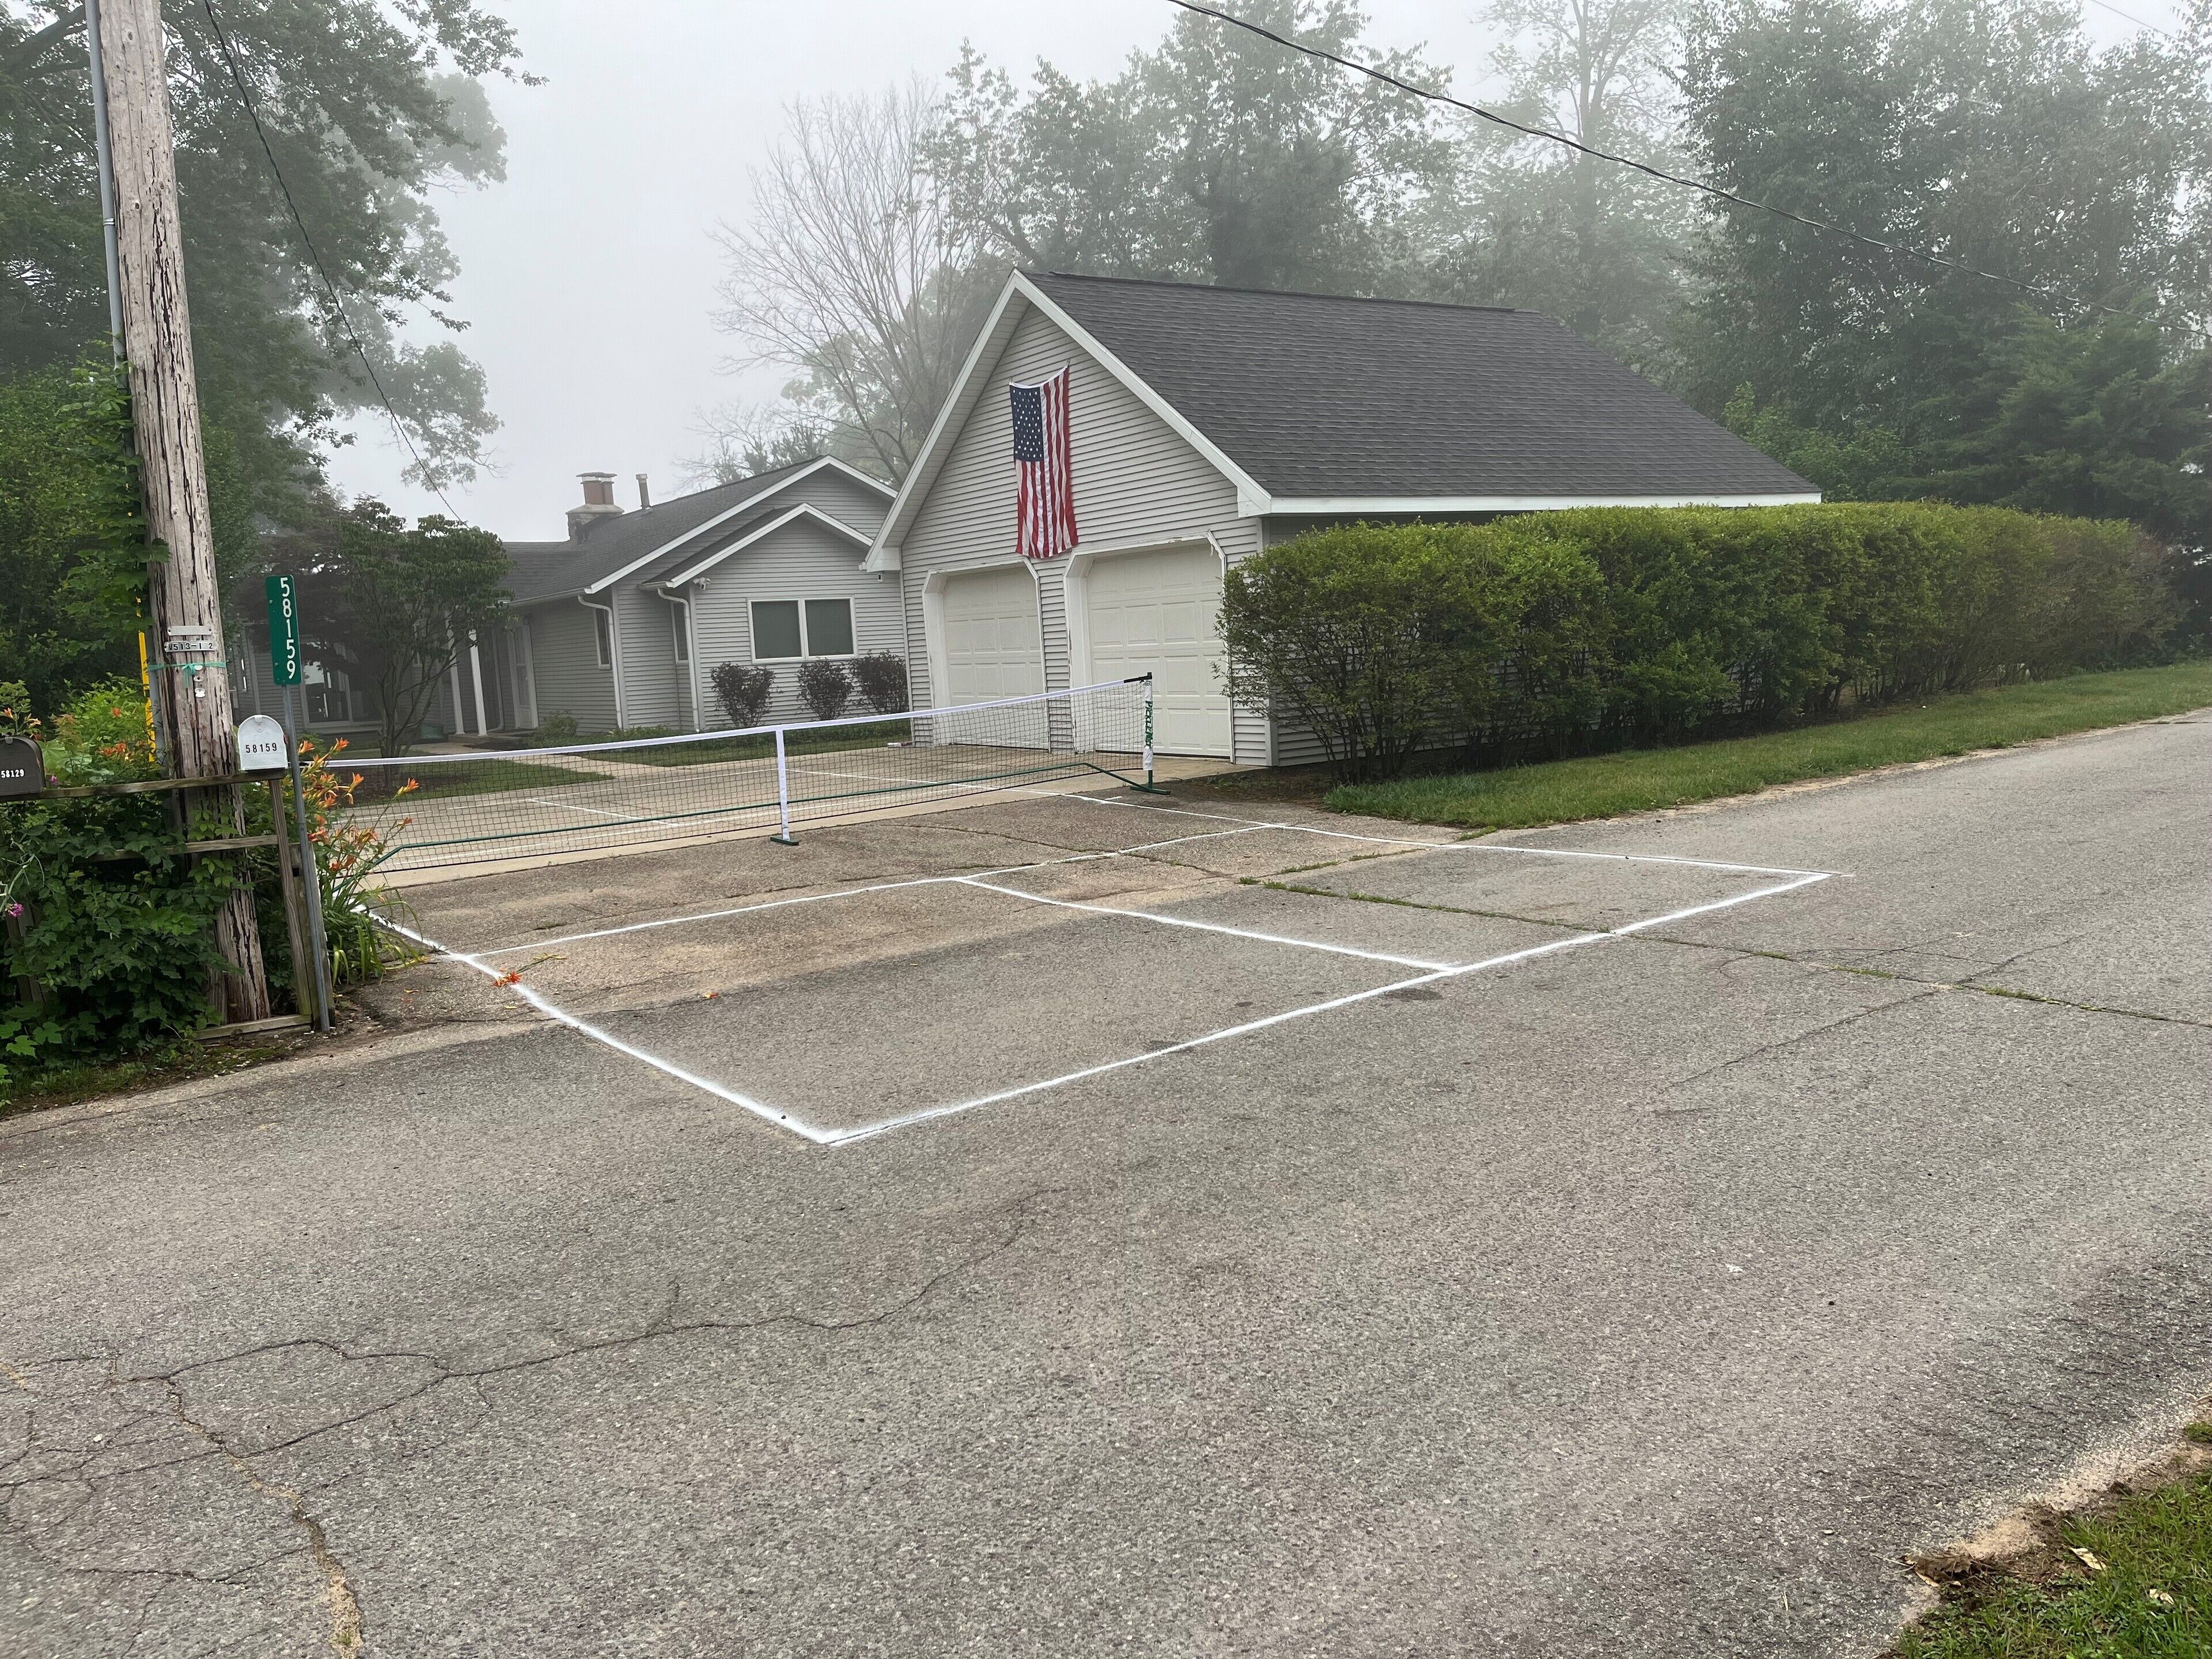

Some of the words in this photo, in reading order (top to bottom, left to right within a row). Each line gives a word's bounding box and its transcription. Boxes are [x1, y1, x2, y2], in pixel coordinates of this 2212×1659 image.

[280, 577, 296, 679] 58159
[245, 743, 277, 753] 58159
[1, 768, 25, 778] 58129
